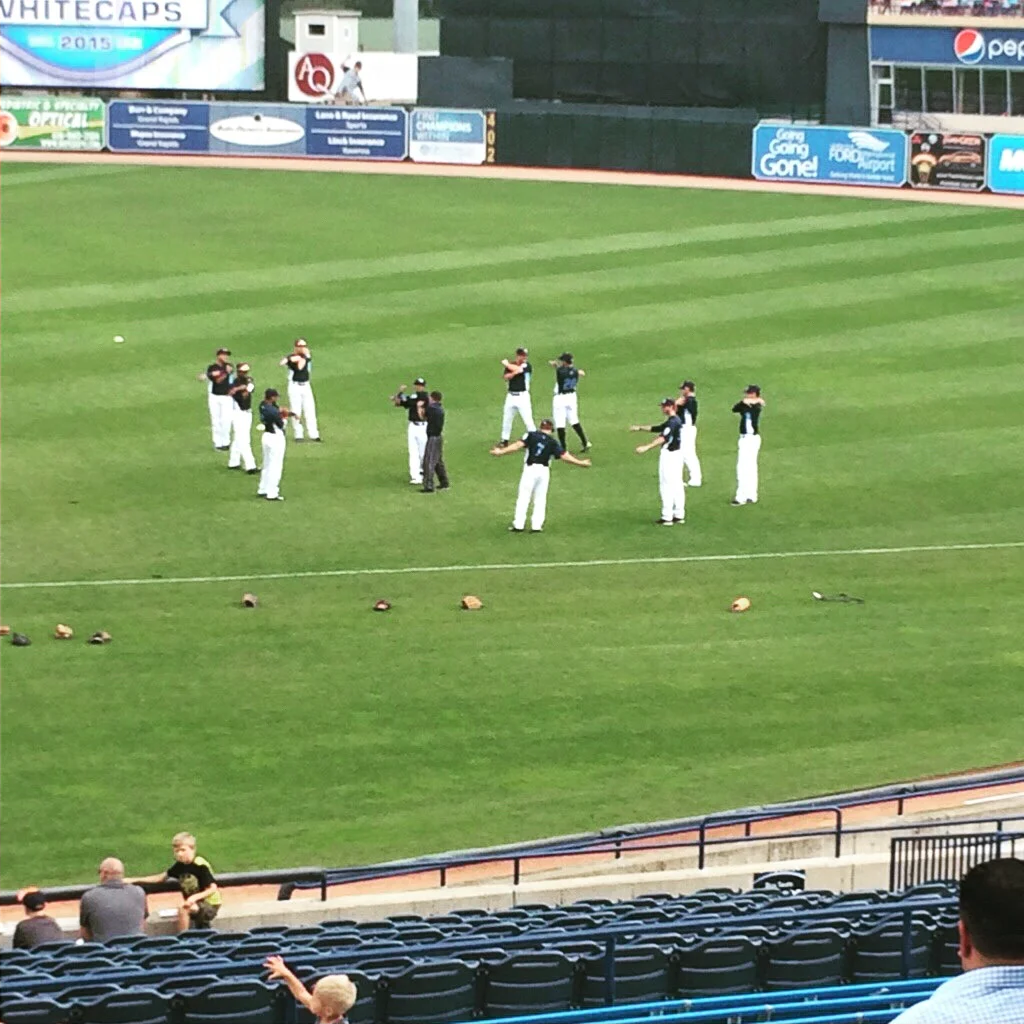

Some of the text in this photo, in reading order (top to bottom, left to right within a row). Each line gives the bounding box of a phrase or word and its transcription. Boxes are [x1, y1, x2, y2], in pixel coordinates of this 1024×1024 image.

[61, 36, 111, 49] 2015
[28, 111, 89, 128] OPTICAL
[776, 128, 805, 143] Going
[769, 139, 809, 159] Going
[760, 153, 818, 177] Gone!
